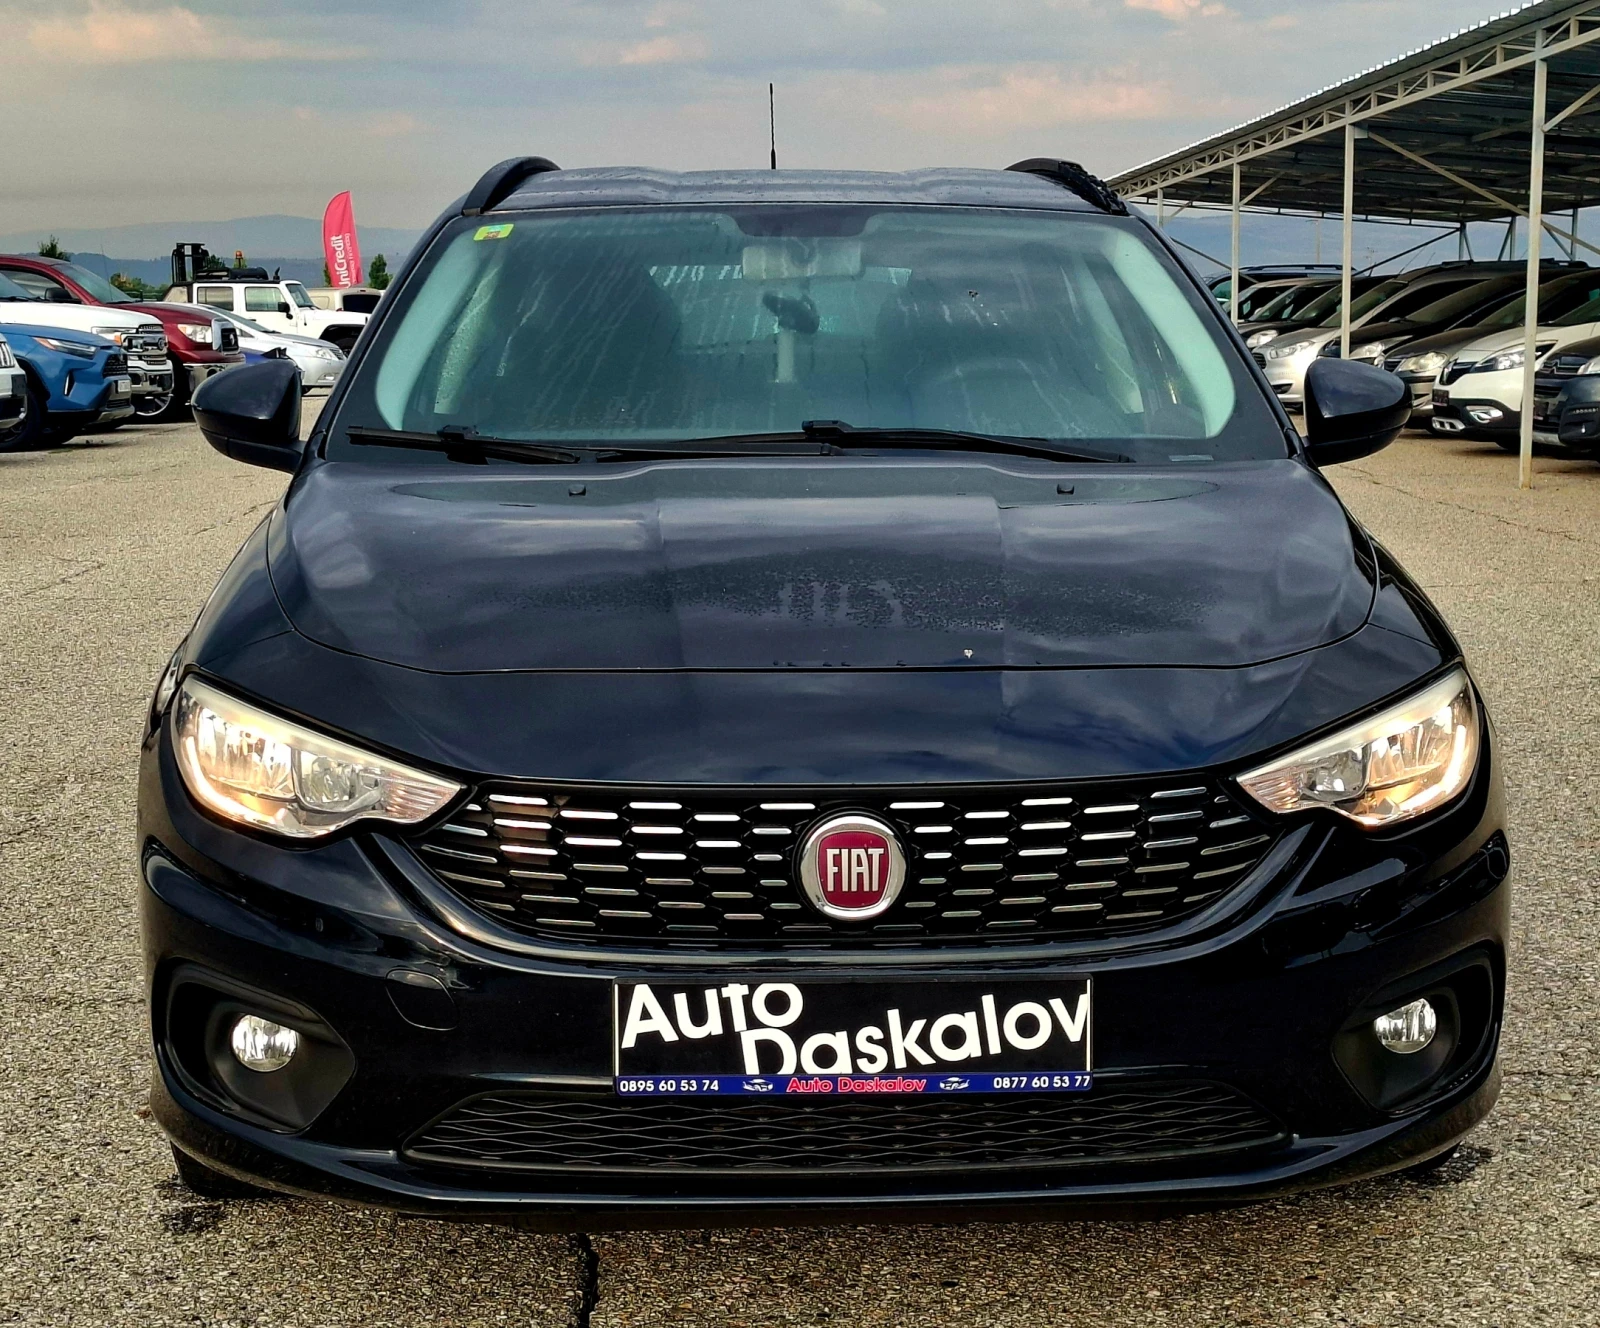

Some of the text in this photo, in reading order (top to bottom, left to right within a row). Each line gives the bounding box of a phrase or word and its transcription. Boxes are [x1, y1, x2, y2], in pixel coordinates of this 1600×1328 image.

[331, 234, 351, 288] UniCredit
[826, 848, 884, 891] FIAT
[621, 983, 803, 1049] Auto
[740, 994, 1088, 1075] Daskalov
[620, 1080, 719, 1092] 0895 60 53 74
[786, 1077, 926, 1092] Auto Daskalov
[993, 1076, 1090, 1088] 0877 60 53 77
